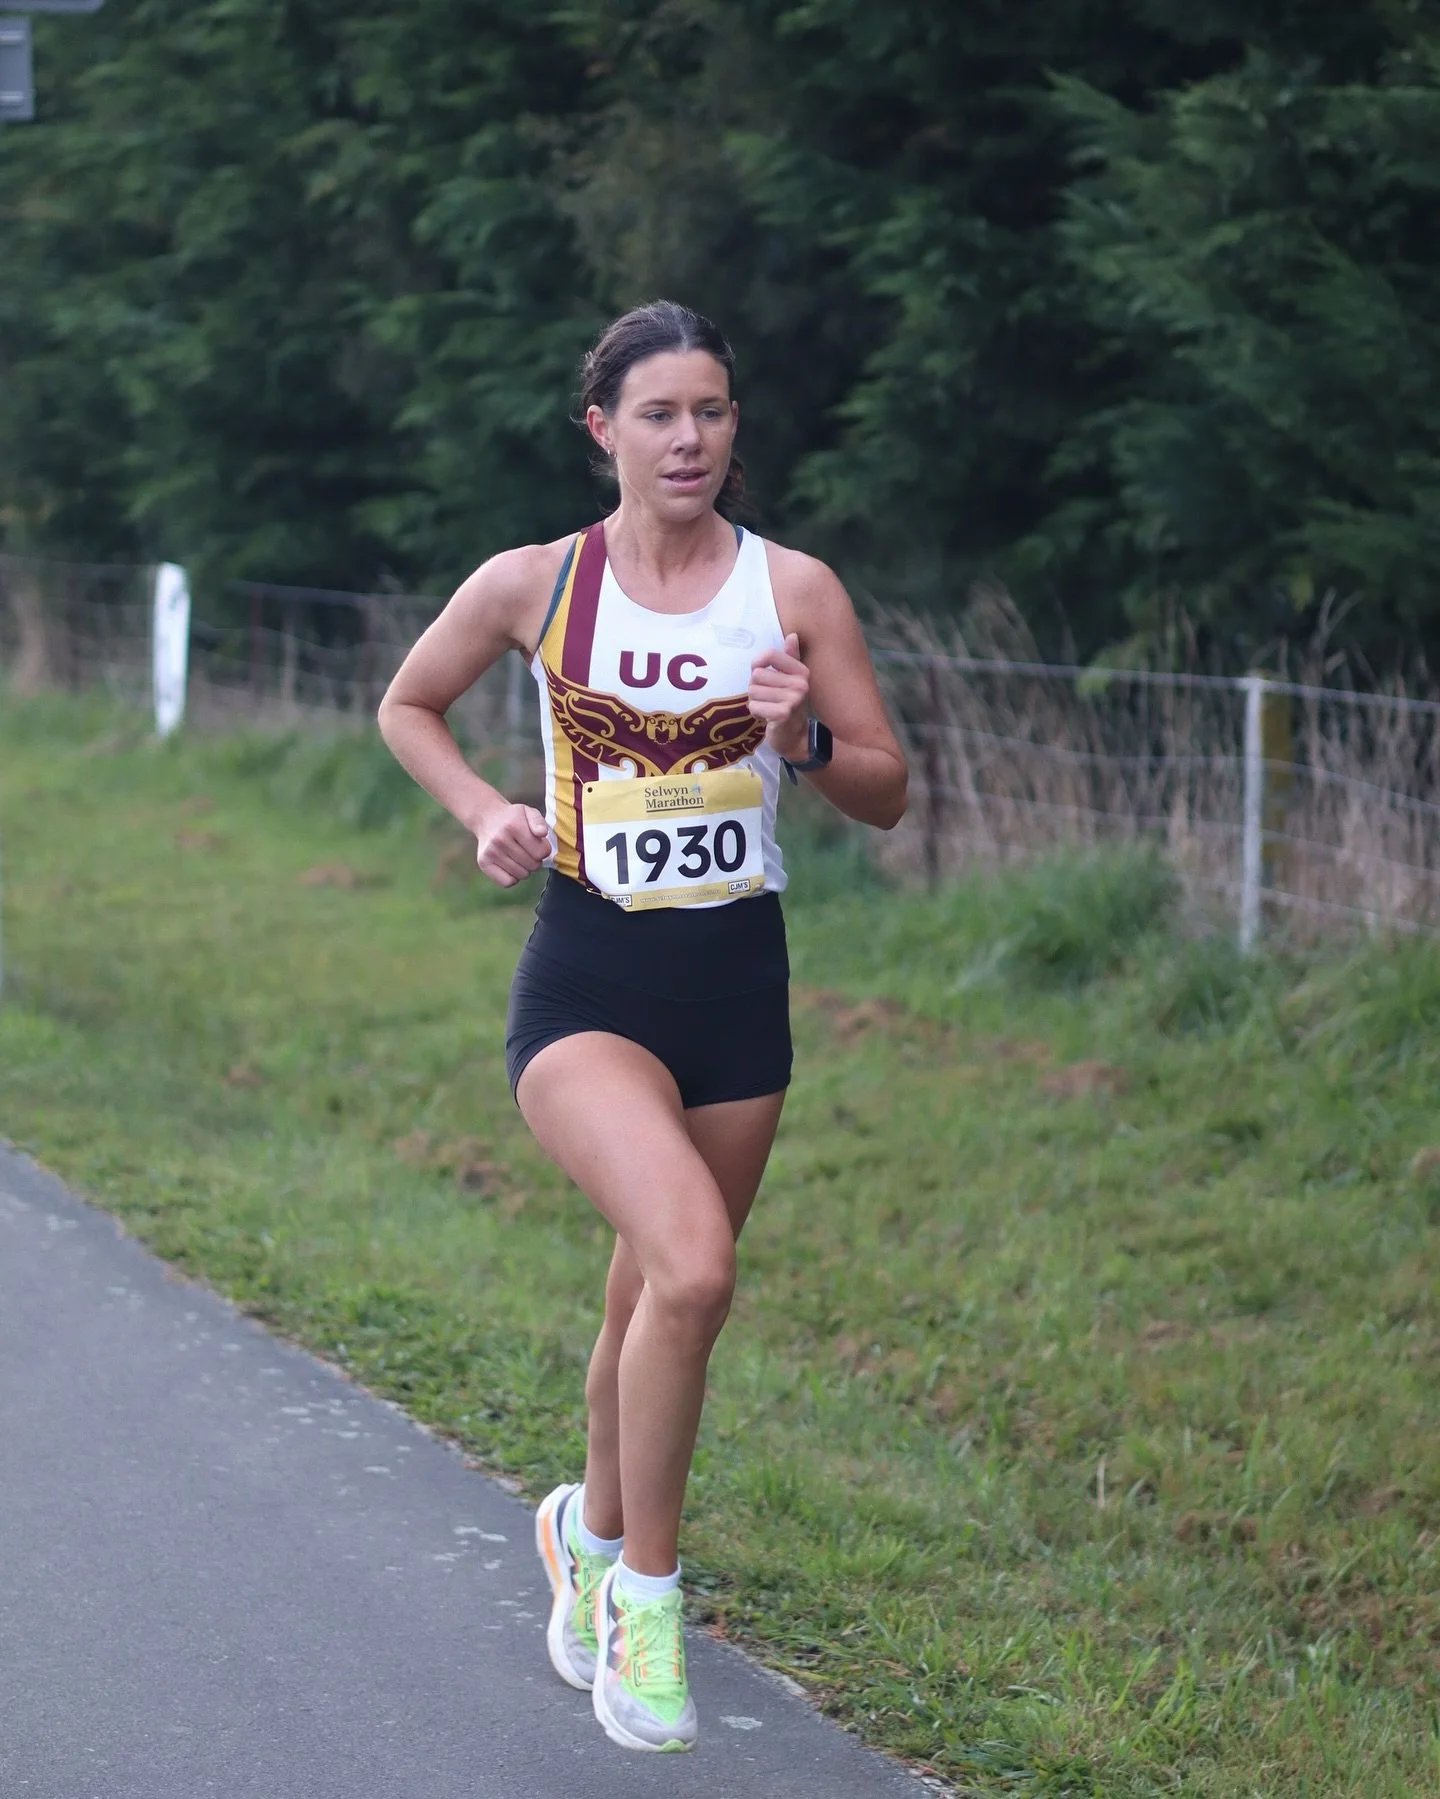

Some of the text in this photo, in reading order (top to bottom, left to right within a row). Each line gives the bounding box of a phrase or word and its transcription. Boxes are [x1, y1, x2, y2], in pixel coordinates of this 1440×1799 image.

[619, 650, 709, 691] UC
[644, 785, 689, 798] Selwyn
[645, 796, 704, 809] Marathon
[605, 819, 746, 885] 1930
